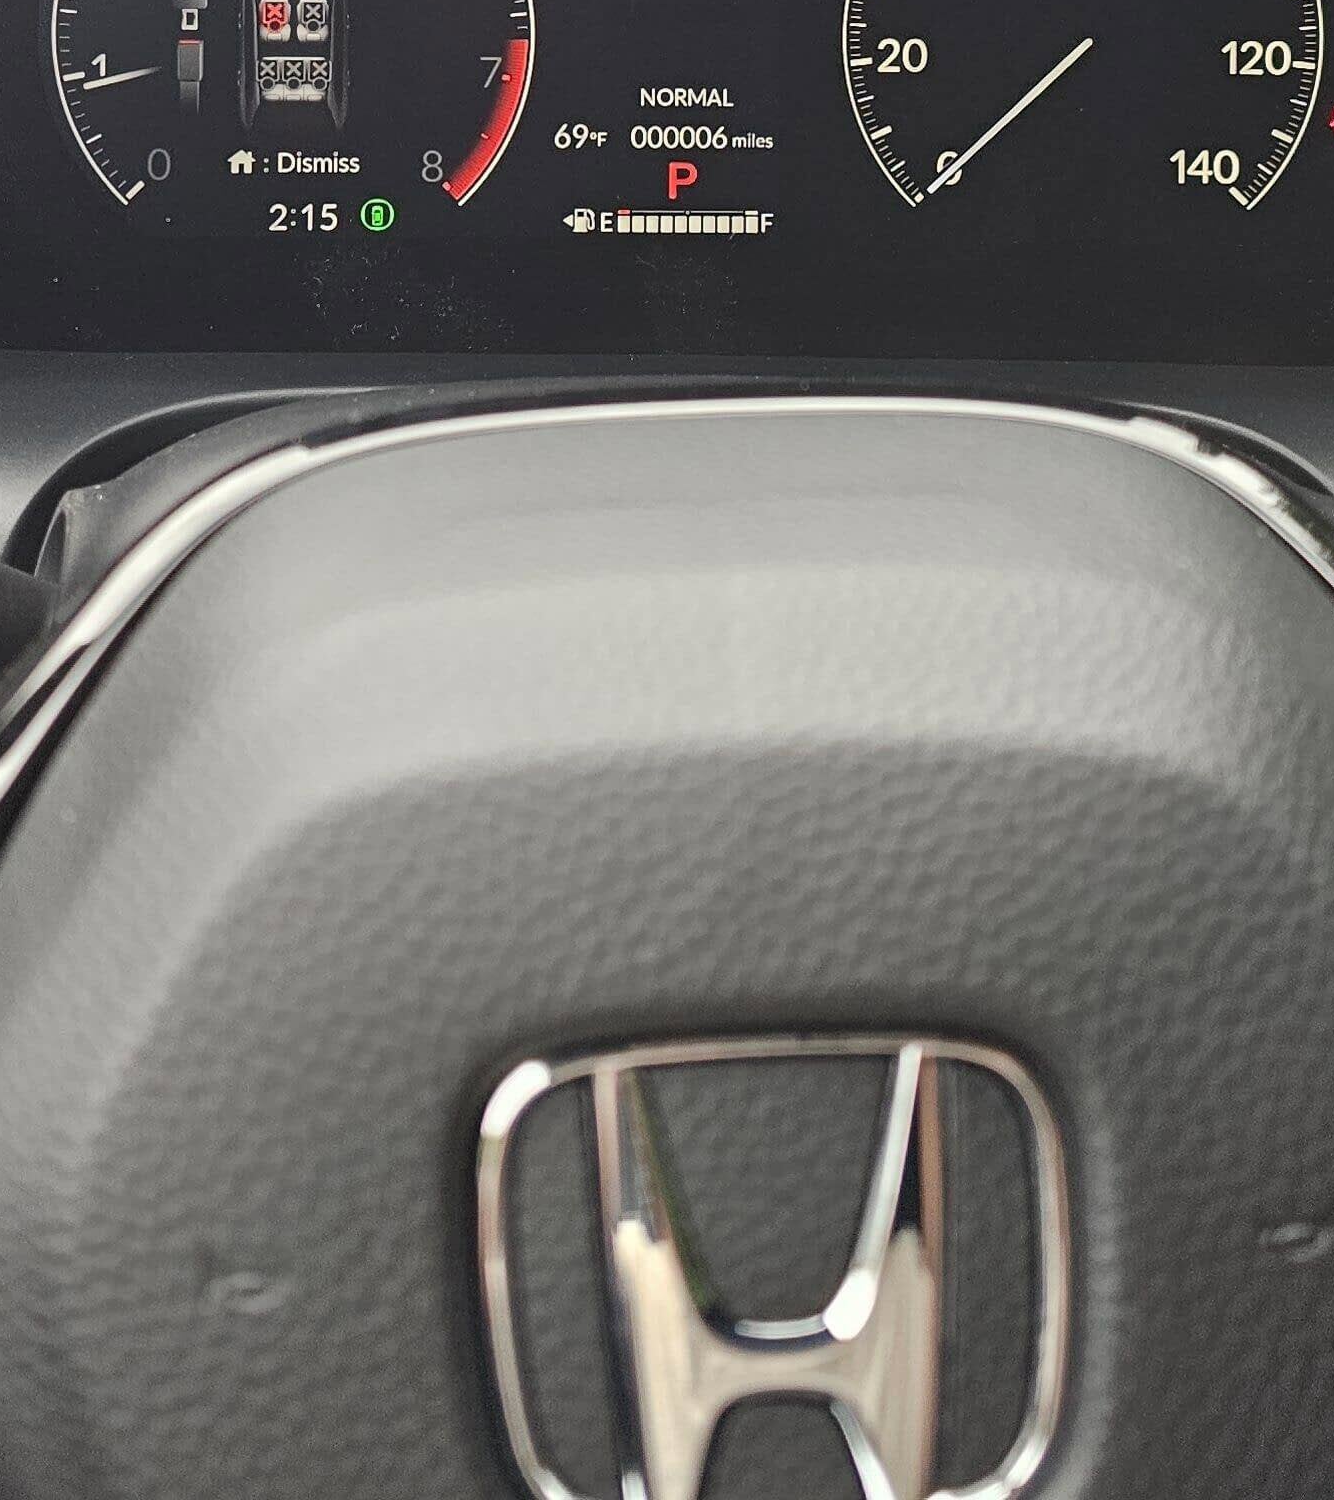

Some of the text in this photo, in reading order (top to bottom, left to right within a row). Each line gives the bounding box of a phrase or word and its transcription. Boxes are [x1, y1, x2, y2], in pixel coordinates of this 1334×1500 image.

[91, 53, 107, 77] 1
[877, 37, 928, 73] 20
[1221, 40, 1292, 76] 120
[479, 56, 502, 89] 7
[640, 87, 735, 107] NORMAL
[630, 125, 728, 150] 000006
[731, 132, 774, 149] miles
[147, 148, 172, 181] 0
[277, 151, 361, 174] Dismiss
[421, 150, 445, 184] 8
[1169, 149, 1240, 185] 140
[668, 161, 698, 200] P
[268, 203, 338, 232] 2:15
[600, 211, 614, 233] E
[760, 213, 774, 234] F
